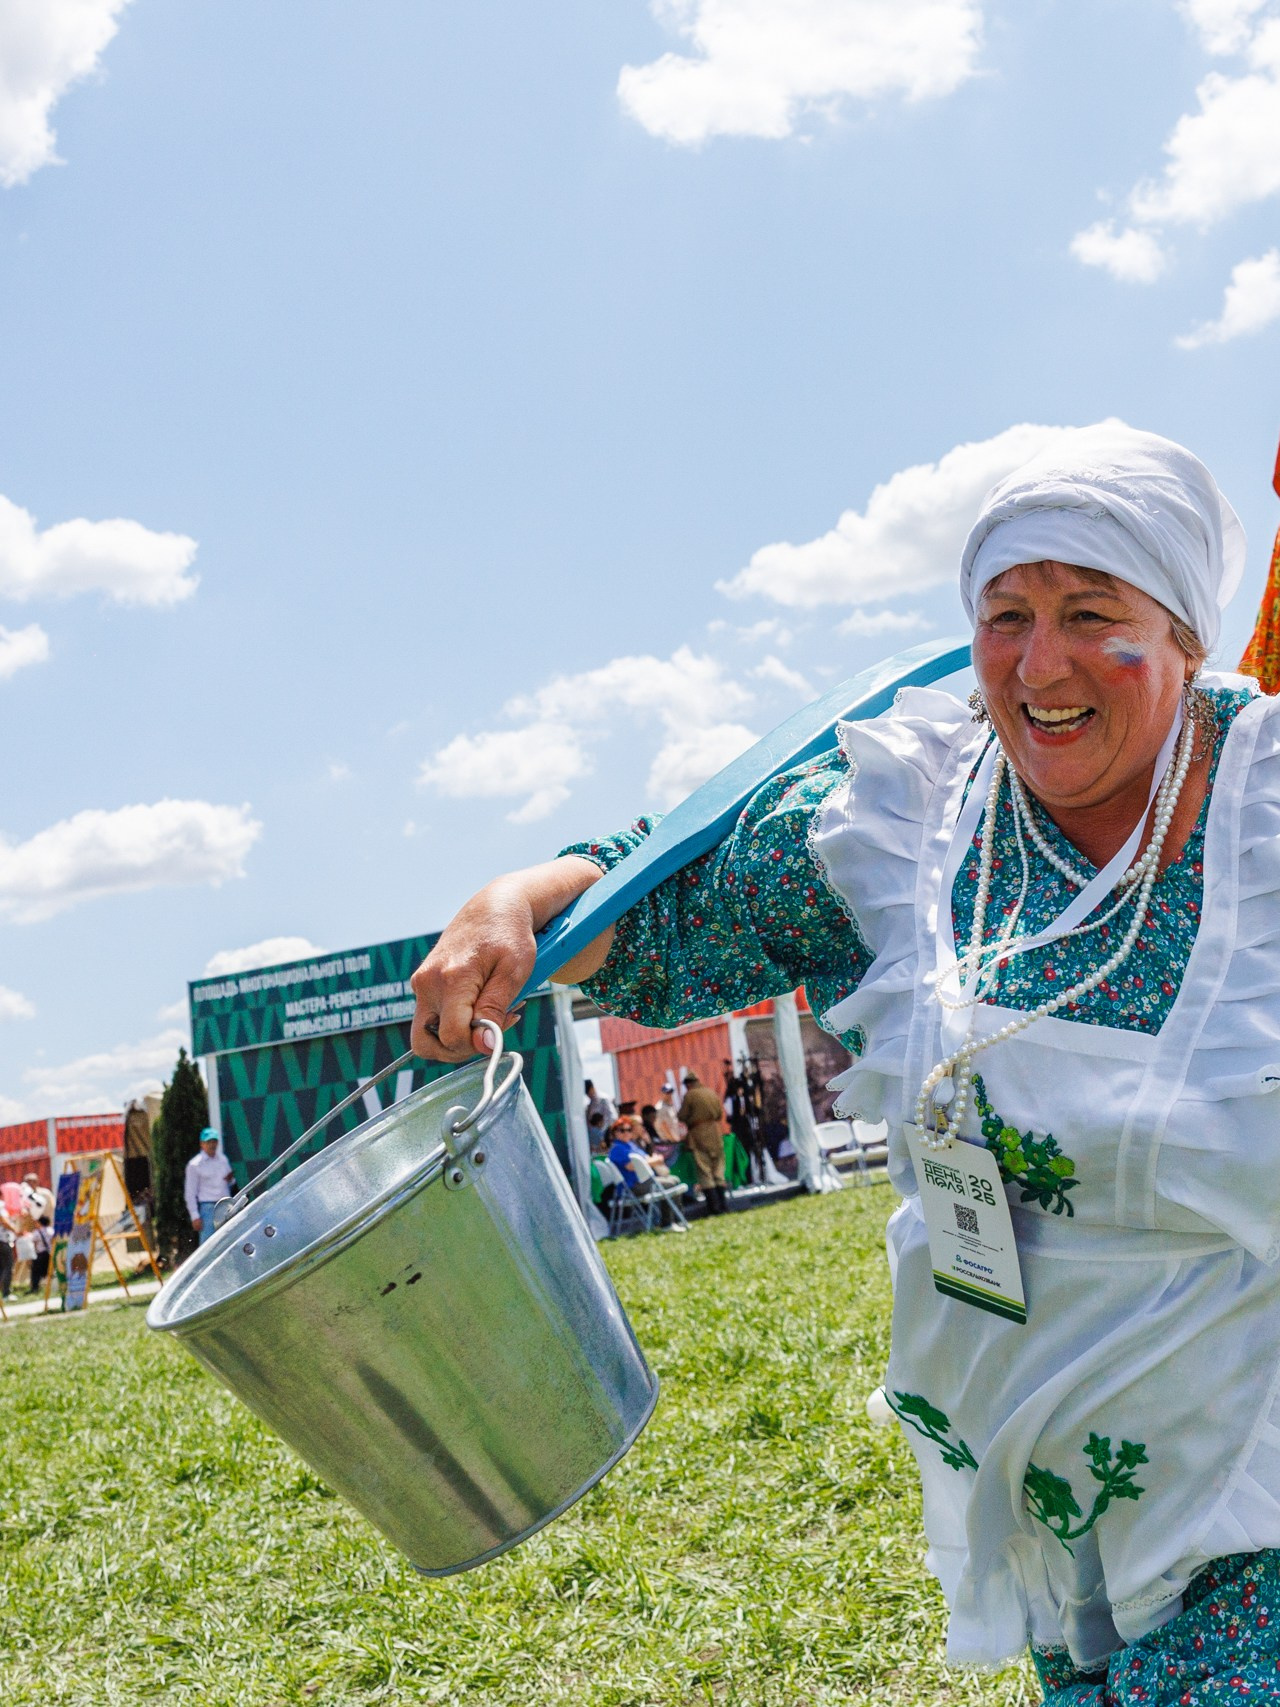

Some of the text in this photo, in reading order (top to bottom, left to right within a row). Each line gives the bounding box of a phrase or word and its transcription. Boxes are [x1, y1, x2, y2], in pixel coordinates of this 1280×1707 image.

[924, 1162, 963, 1185] ДЕНЬ
[968, 1174, 993, 1193] 20
[925, 1173, 965, 1195] ПОЛЯ
[971, 1188, 996, 1207] 25
